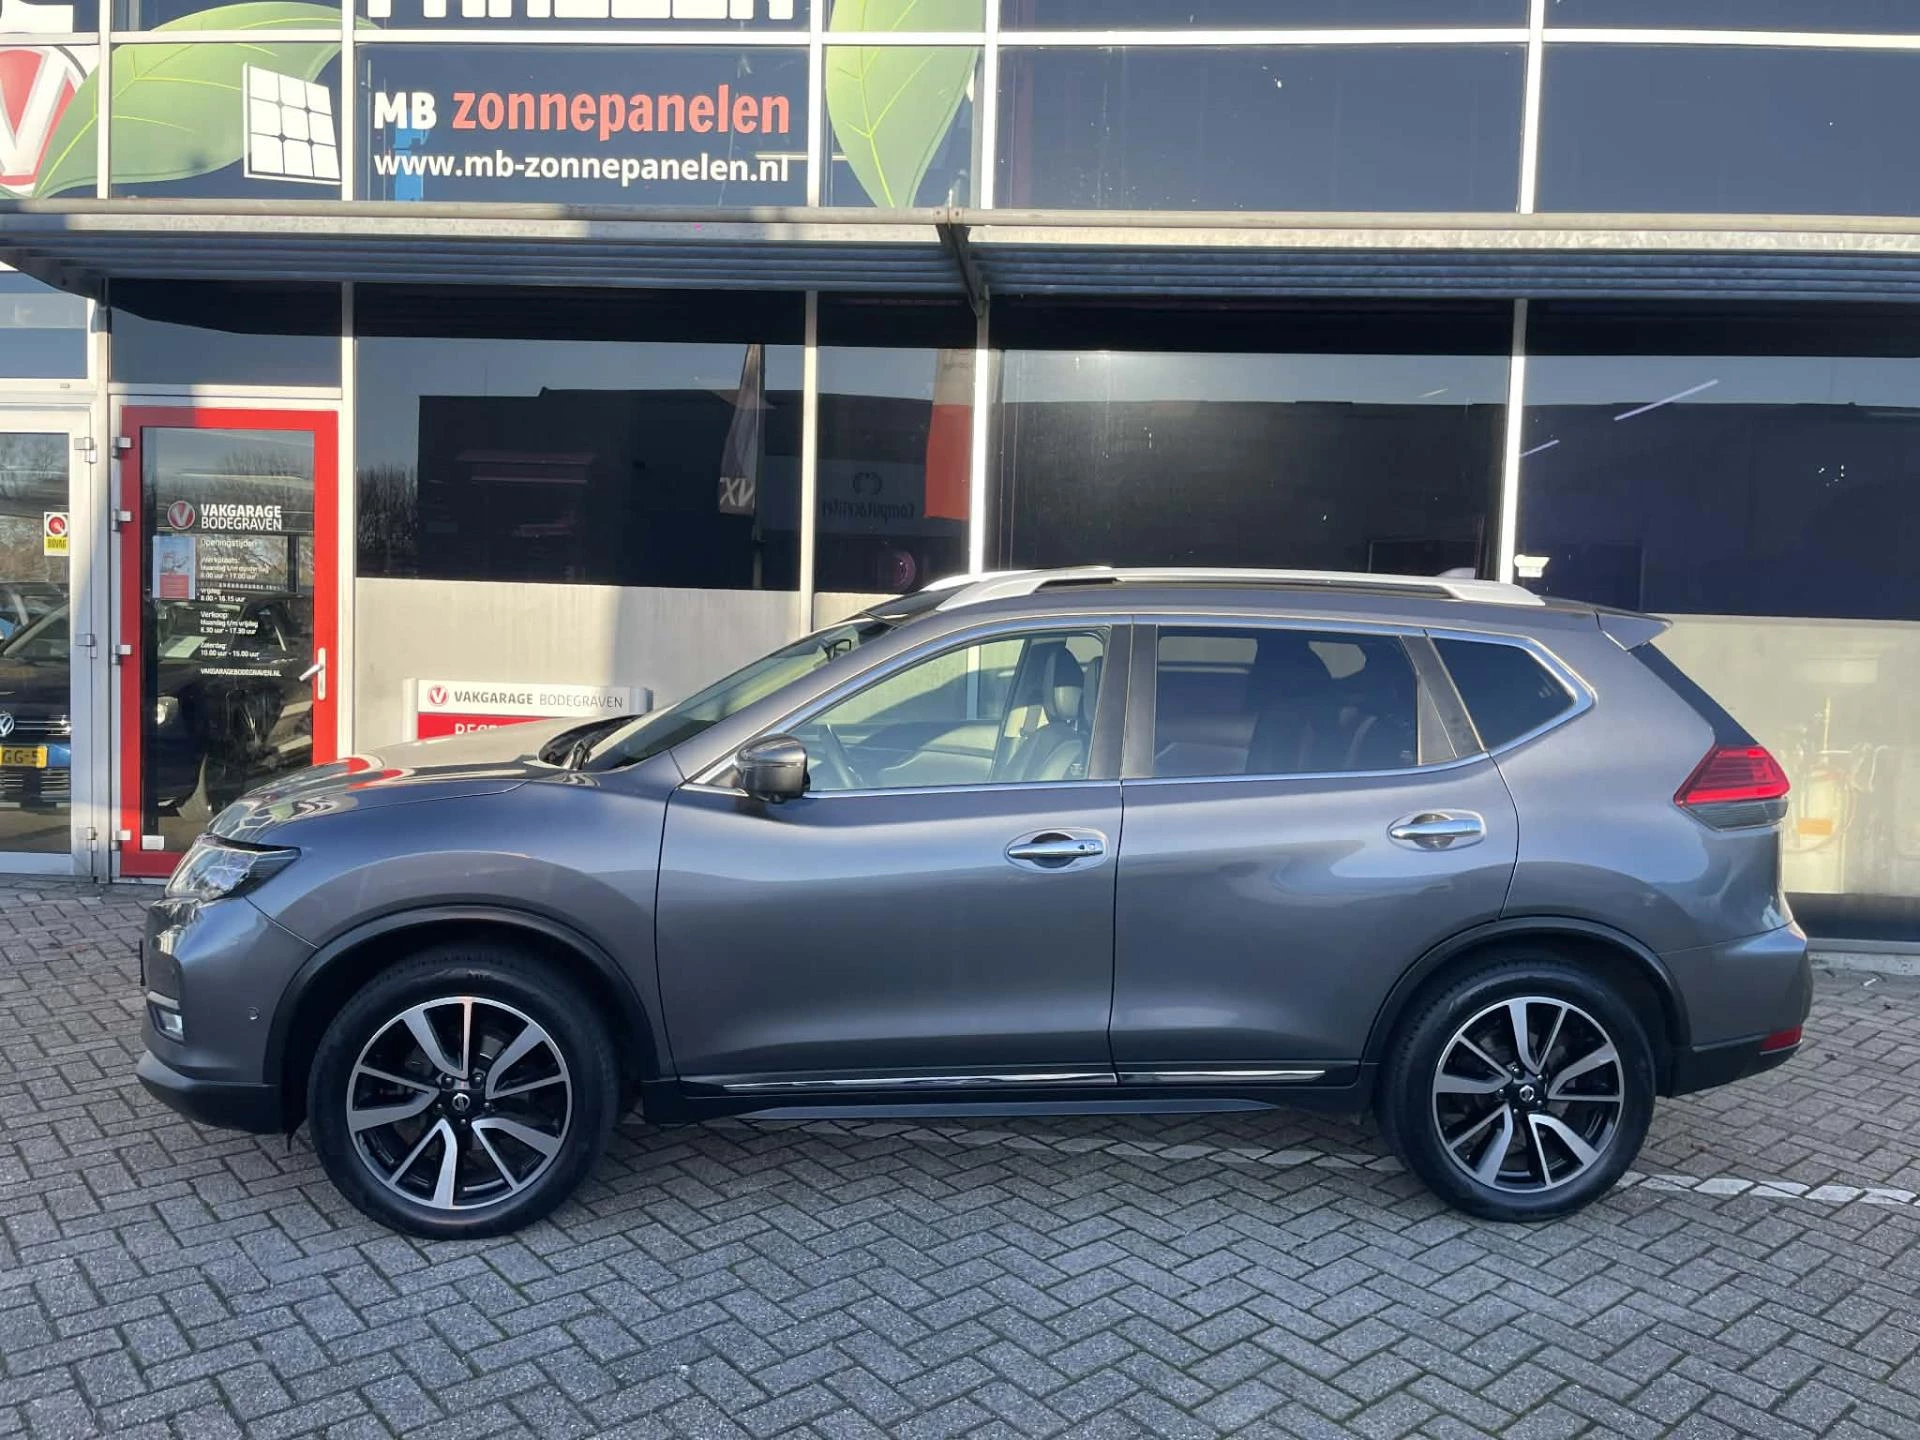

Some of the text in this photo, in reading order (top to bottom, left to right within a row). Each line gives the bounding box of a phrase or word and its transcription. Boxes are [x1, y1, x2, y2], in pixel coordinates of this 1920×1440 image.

[373, 83, 791, 142] MB zonnepanelen
[373, 149, 790, 187] www.mb-zonnepanelen.nl
[200, 503, 282, 518] VAKGARAGE
[200, 517, 283, 531] BODEGRAVEN
[454, 690, 534, 705] VAKGARAGE
[539, 692, 624, 708] BODEGRAVEN
